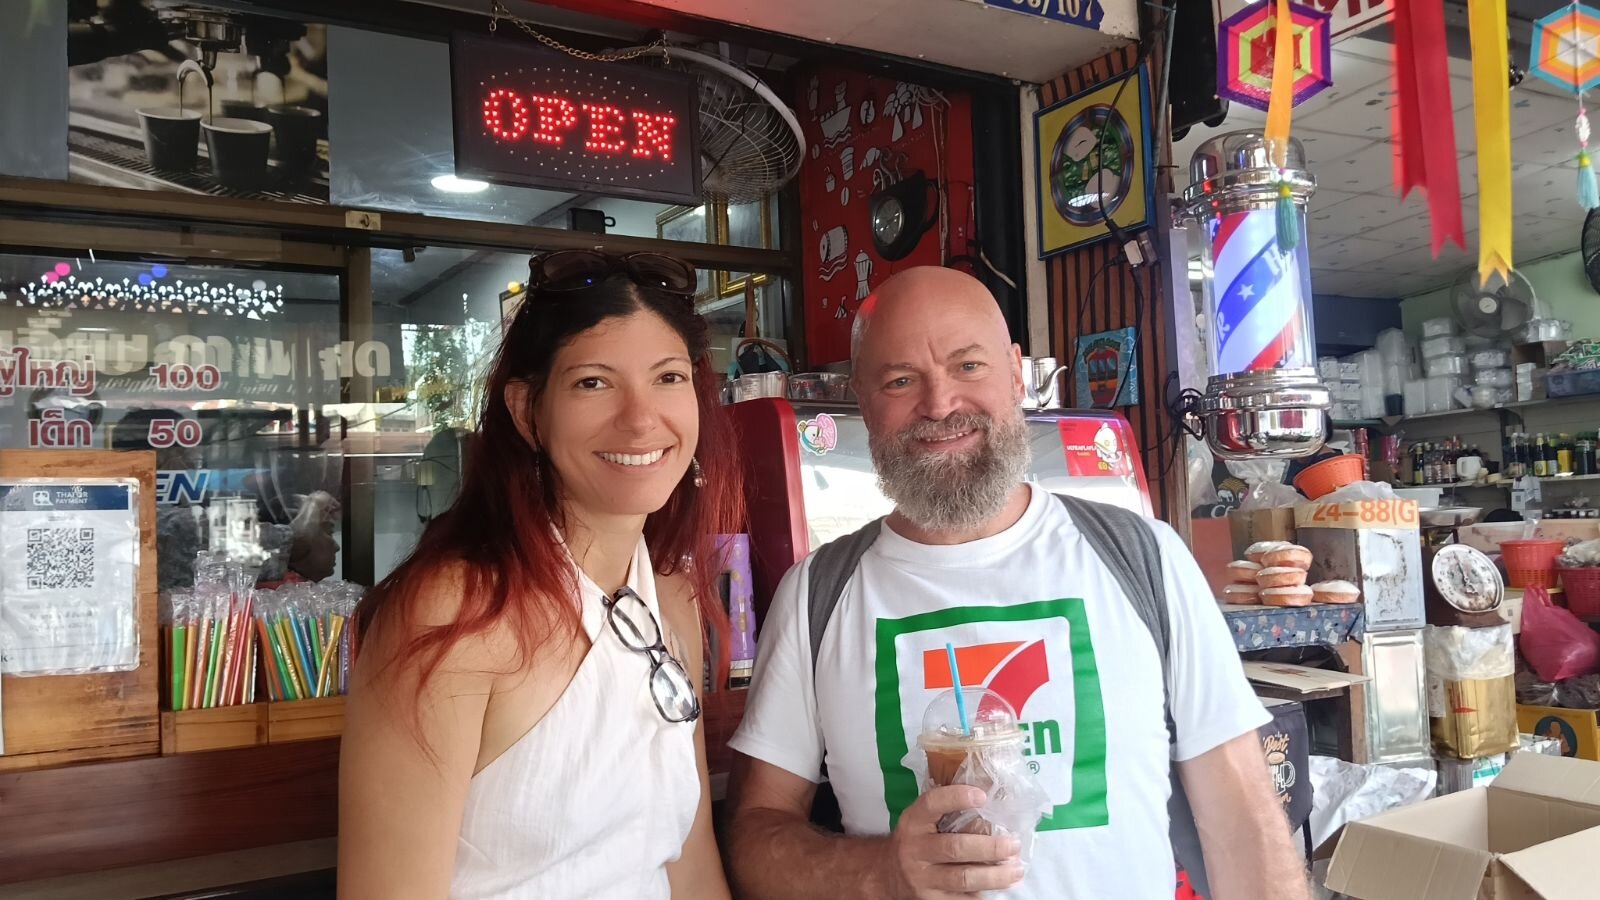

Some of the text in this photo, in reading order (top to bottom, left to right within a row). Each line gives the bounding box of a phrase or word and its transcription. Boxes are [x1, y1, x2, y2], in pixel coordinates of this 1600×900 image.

[482, 88, 677, 161] OPEN
[150, 363, 220, 392] 100
[29, 409, 202, 447] เด็ก 50
